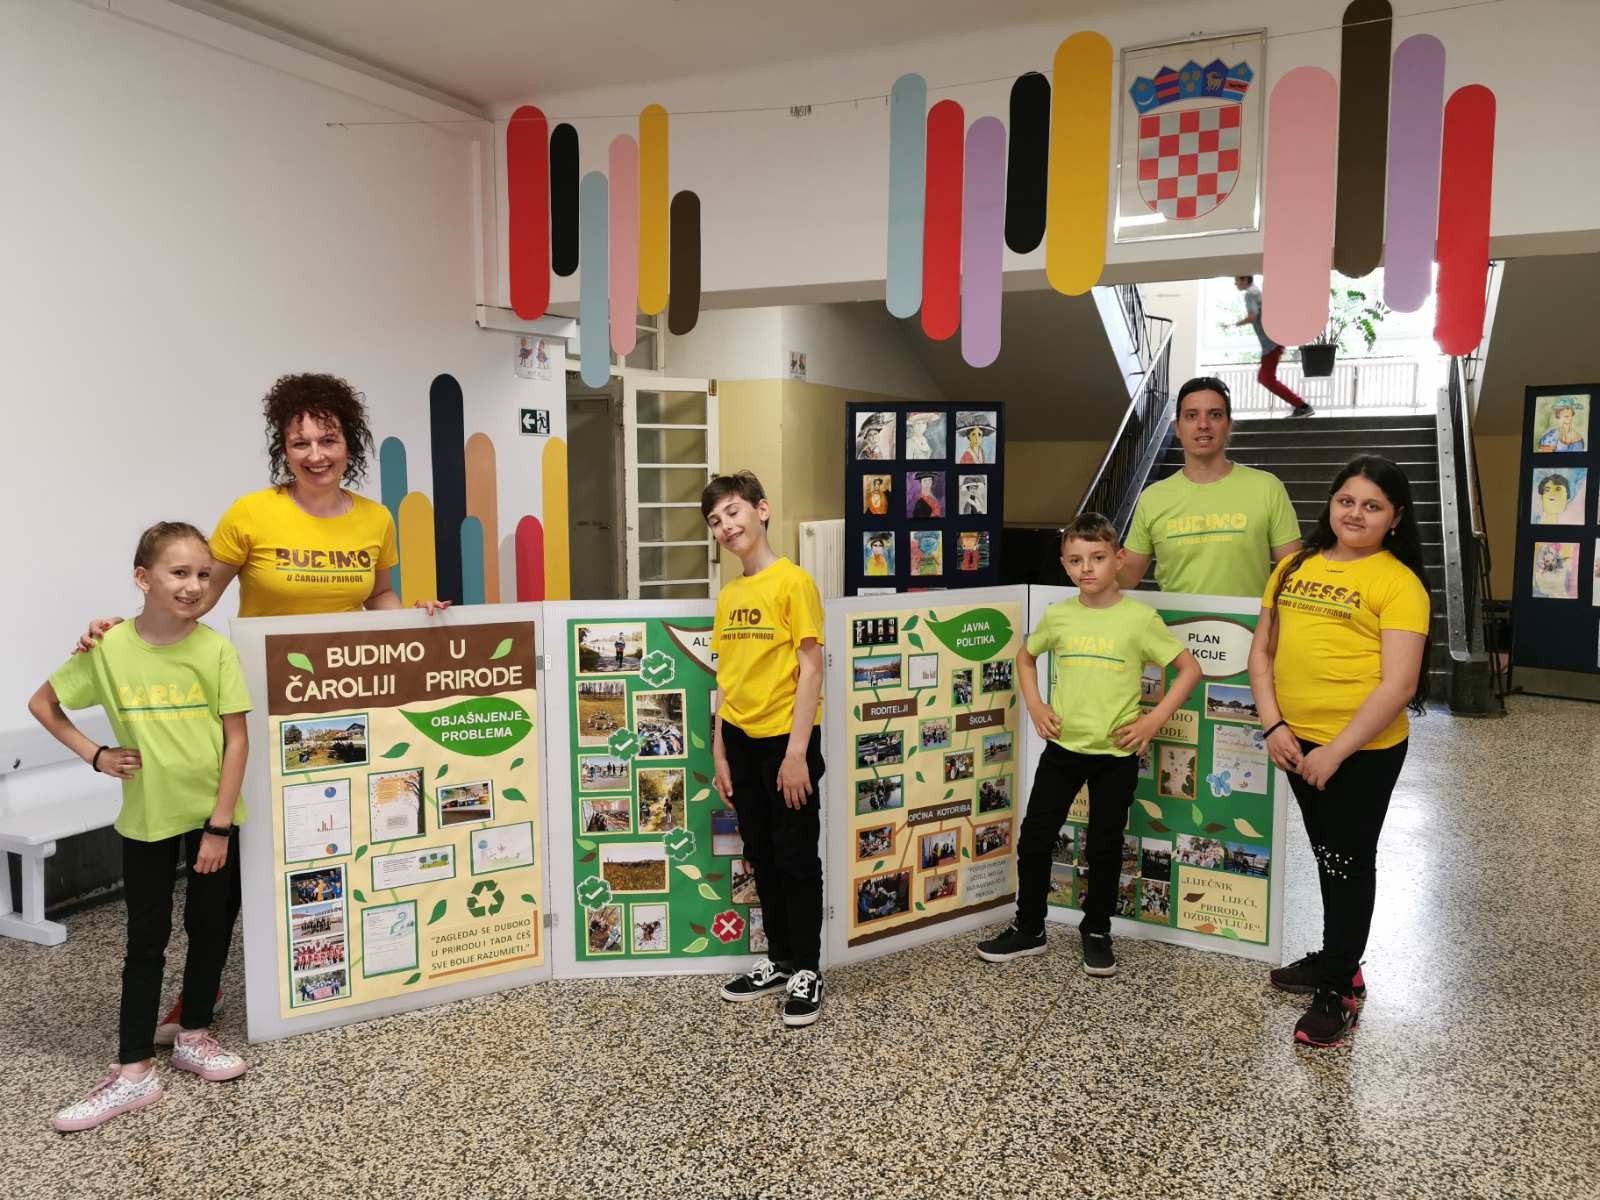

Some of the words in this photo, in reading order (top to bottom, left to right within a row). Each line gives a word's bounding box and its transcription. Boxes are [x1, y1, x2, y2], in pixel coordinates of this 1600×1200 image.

[275, 548, 371, 568] BUDIMO
[1282, 577, 1361, 609] ANESSA
[961, 621, 990, 633] JAVNA
[956, 634, 996, 648] POLITIKA
[1188, 632, 1220, 645] PLAN
[326, 641, 425, 668] BUDIMO
[450, 639, 466, 660] U
[1191, 648, 1227, 661] KCIJE
[285, 674, 396, 703] ČAROLIJI
[425, 665, 523, 692] PRIRODE
[870, 704, 909, 716] RODITELJI
[431, 710, 523, 727] OBJAŠNJENJE
[968, 714, 993, 726] ŠKOLA
[441, 727, 513, 742] PROBLEMA
[1200, 904, 1246, 918] PRIRODA
[481, 926, 492, 935] SE
[494, 919, 531, 932] DUBOKO
[431, 949, 438, 957] U
[442, 941, 481, 955] PRIRODU
[490, 935, 513, 945] TADA
[431, 961, 448, 971] SVE
[450, 955, 475, 967] BOLJE
